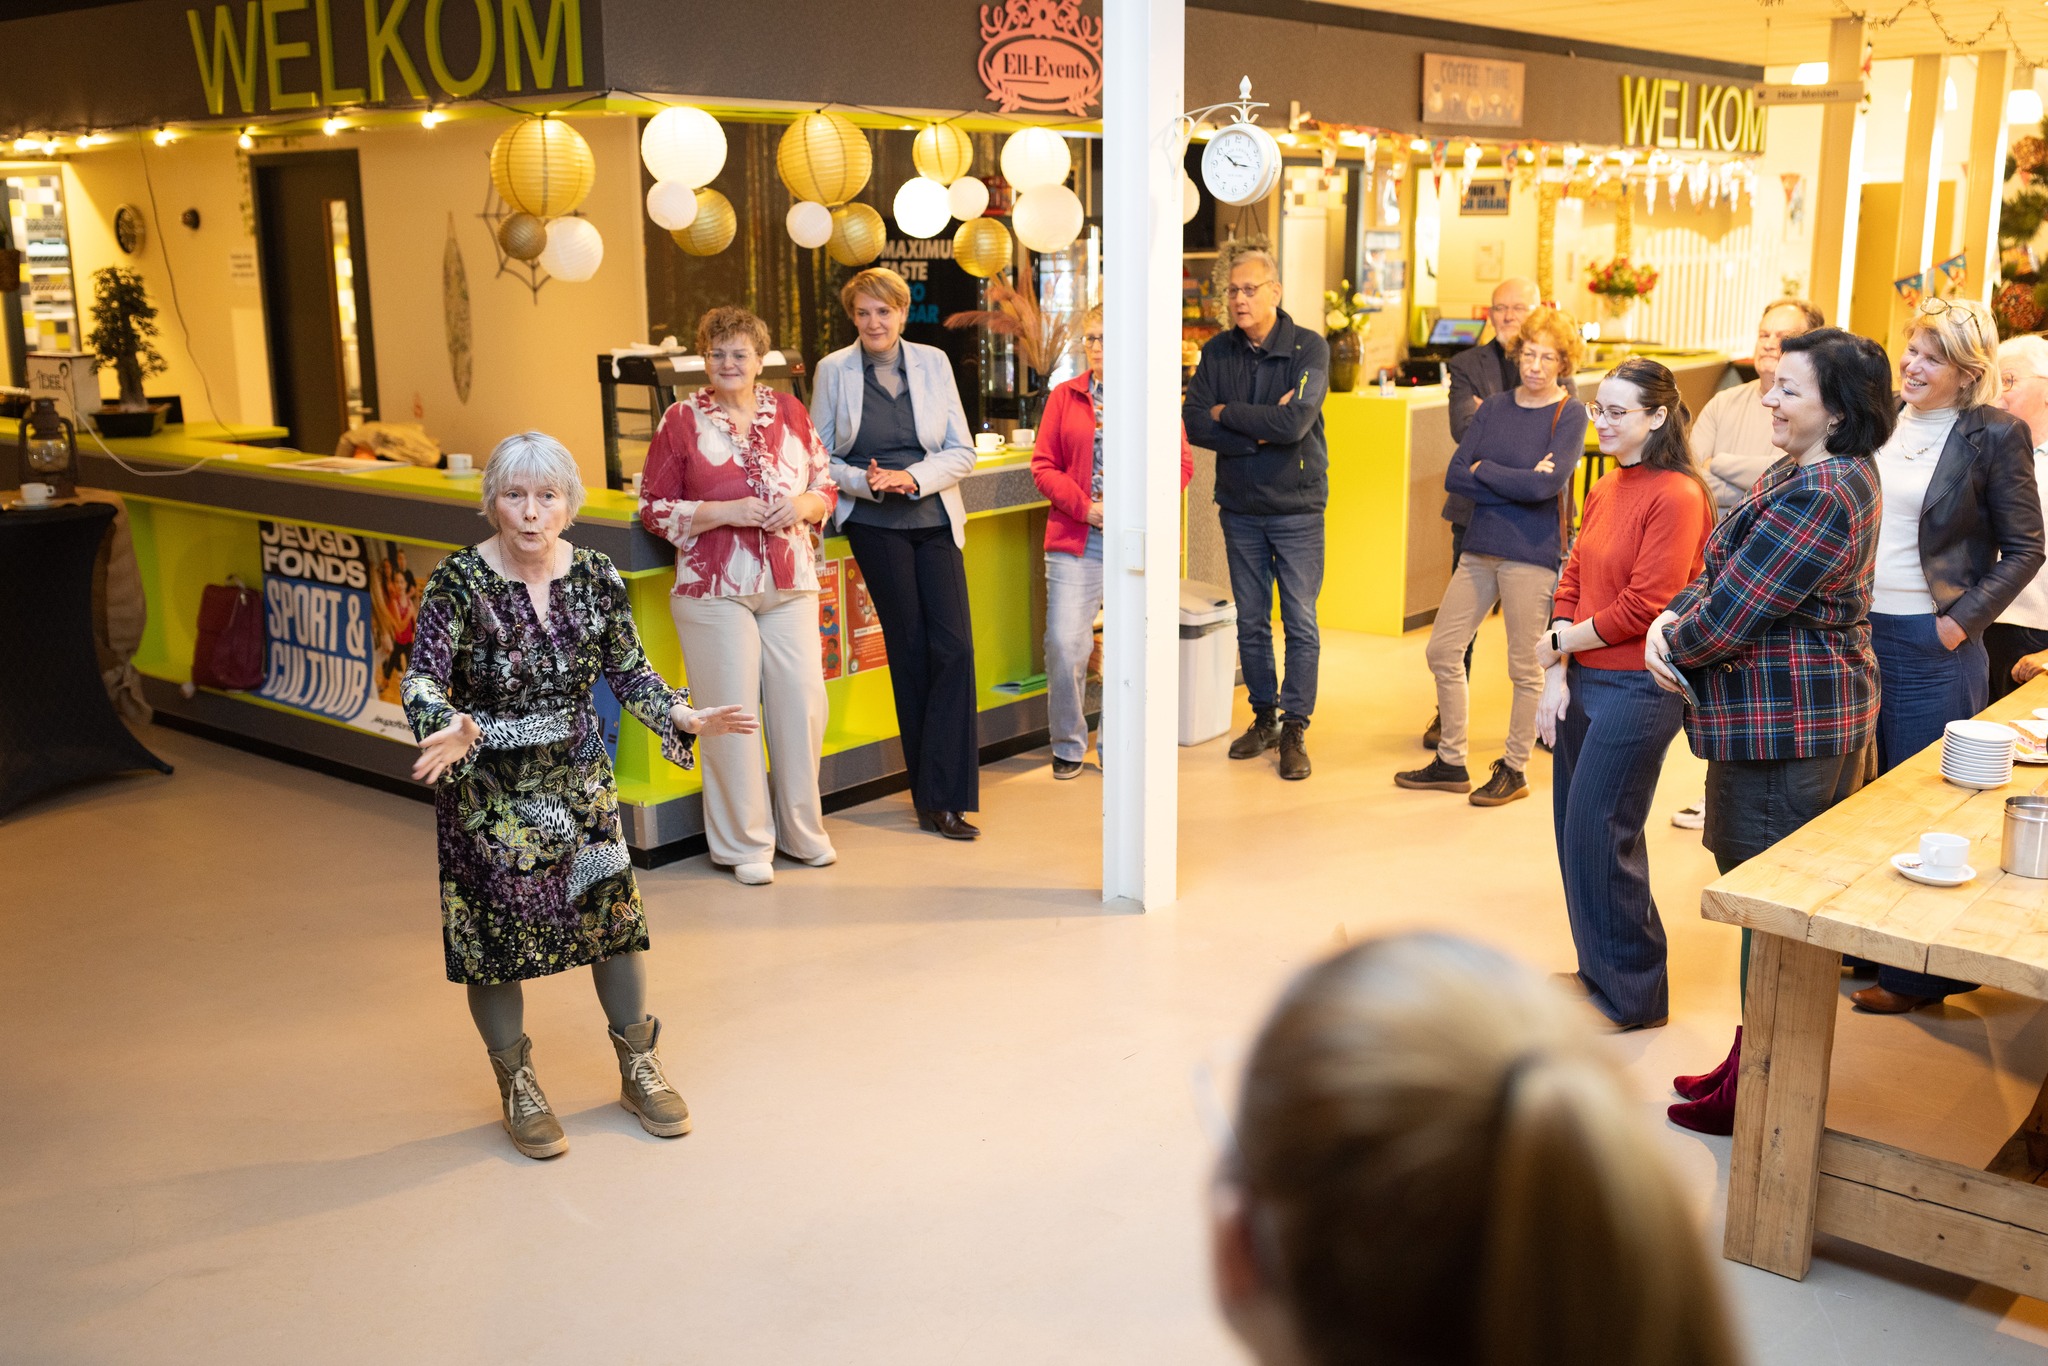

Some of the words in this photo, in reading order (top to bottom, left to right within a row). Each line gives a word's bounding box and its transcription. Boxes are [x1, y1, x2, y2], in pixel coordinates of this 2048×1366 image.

[187, 0, 584, 115] WELKOM
[1003, 52, 1090, 79] Ell-Events
[1622, 74, 1766, 152] WELKOM
[880, 239, 955, 259] MAXIMU
[261, 521, 361, 558] JEUGD
[263, 545, 368, 589] FONDS
[266, 578, 342, 653] SPORT
[346, 594, 367, 659] &
[261, 641, 369, 719] CULTUUR
